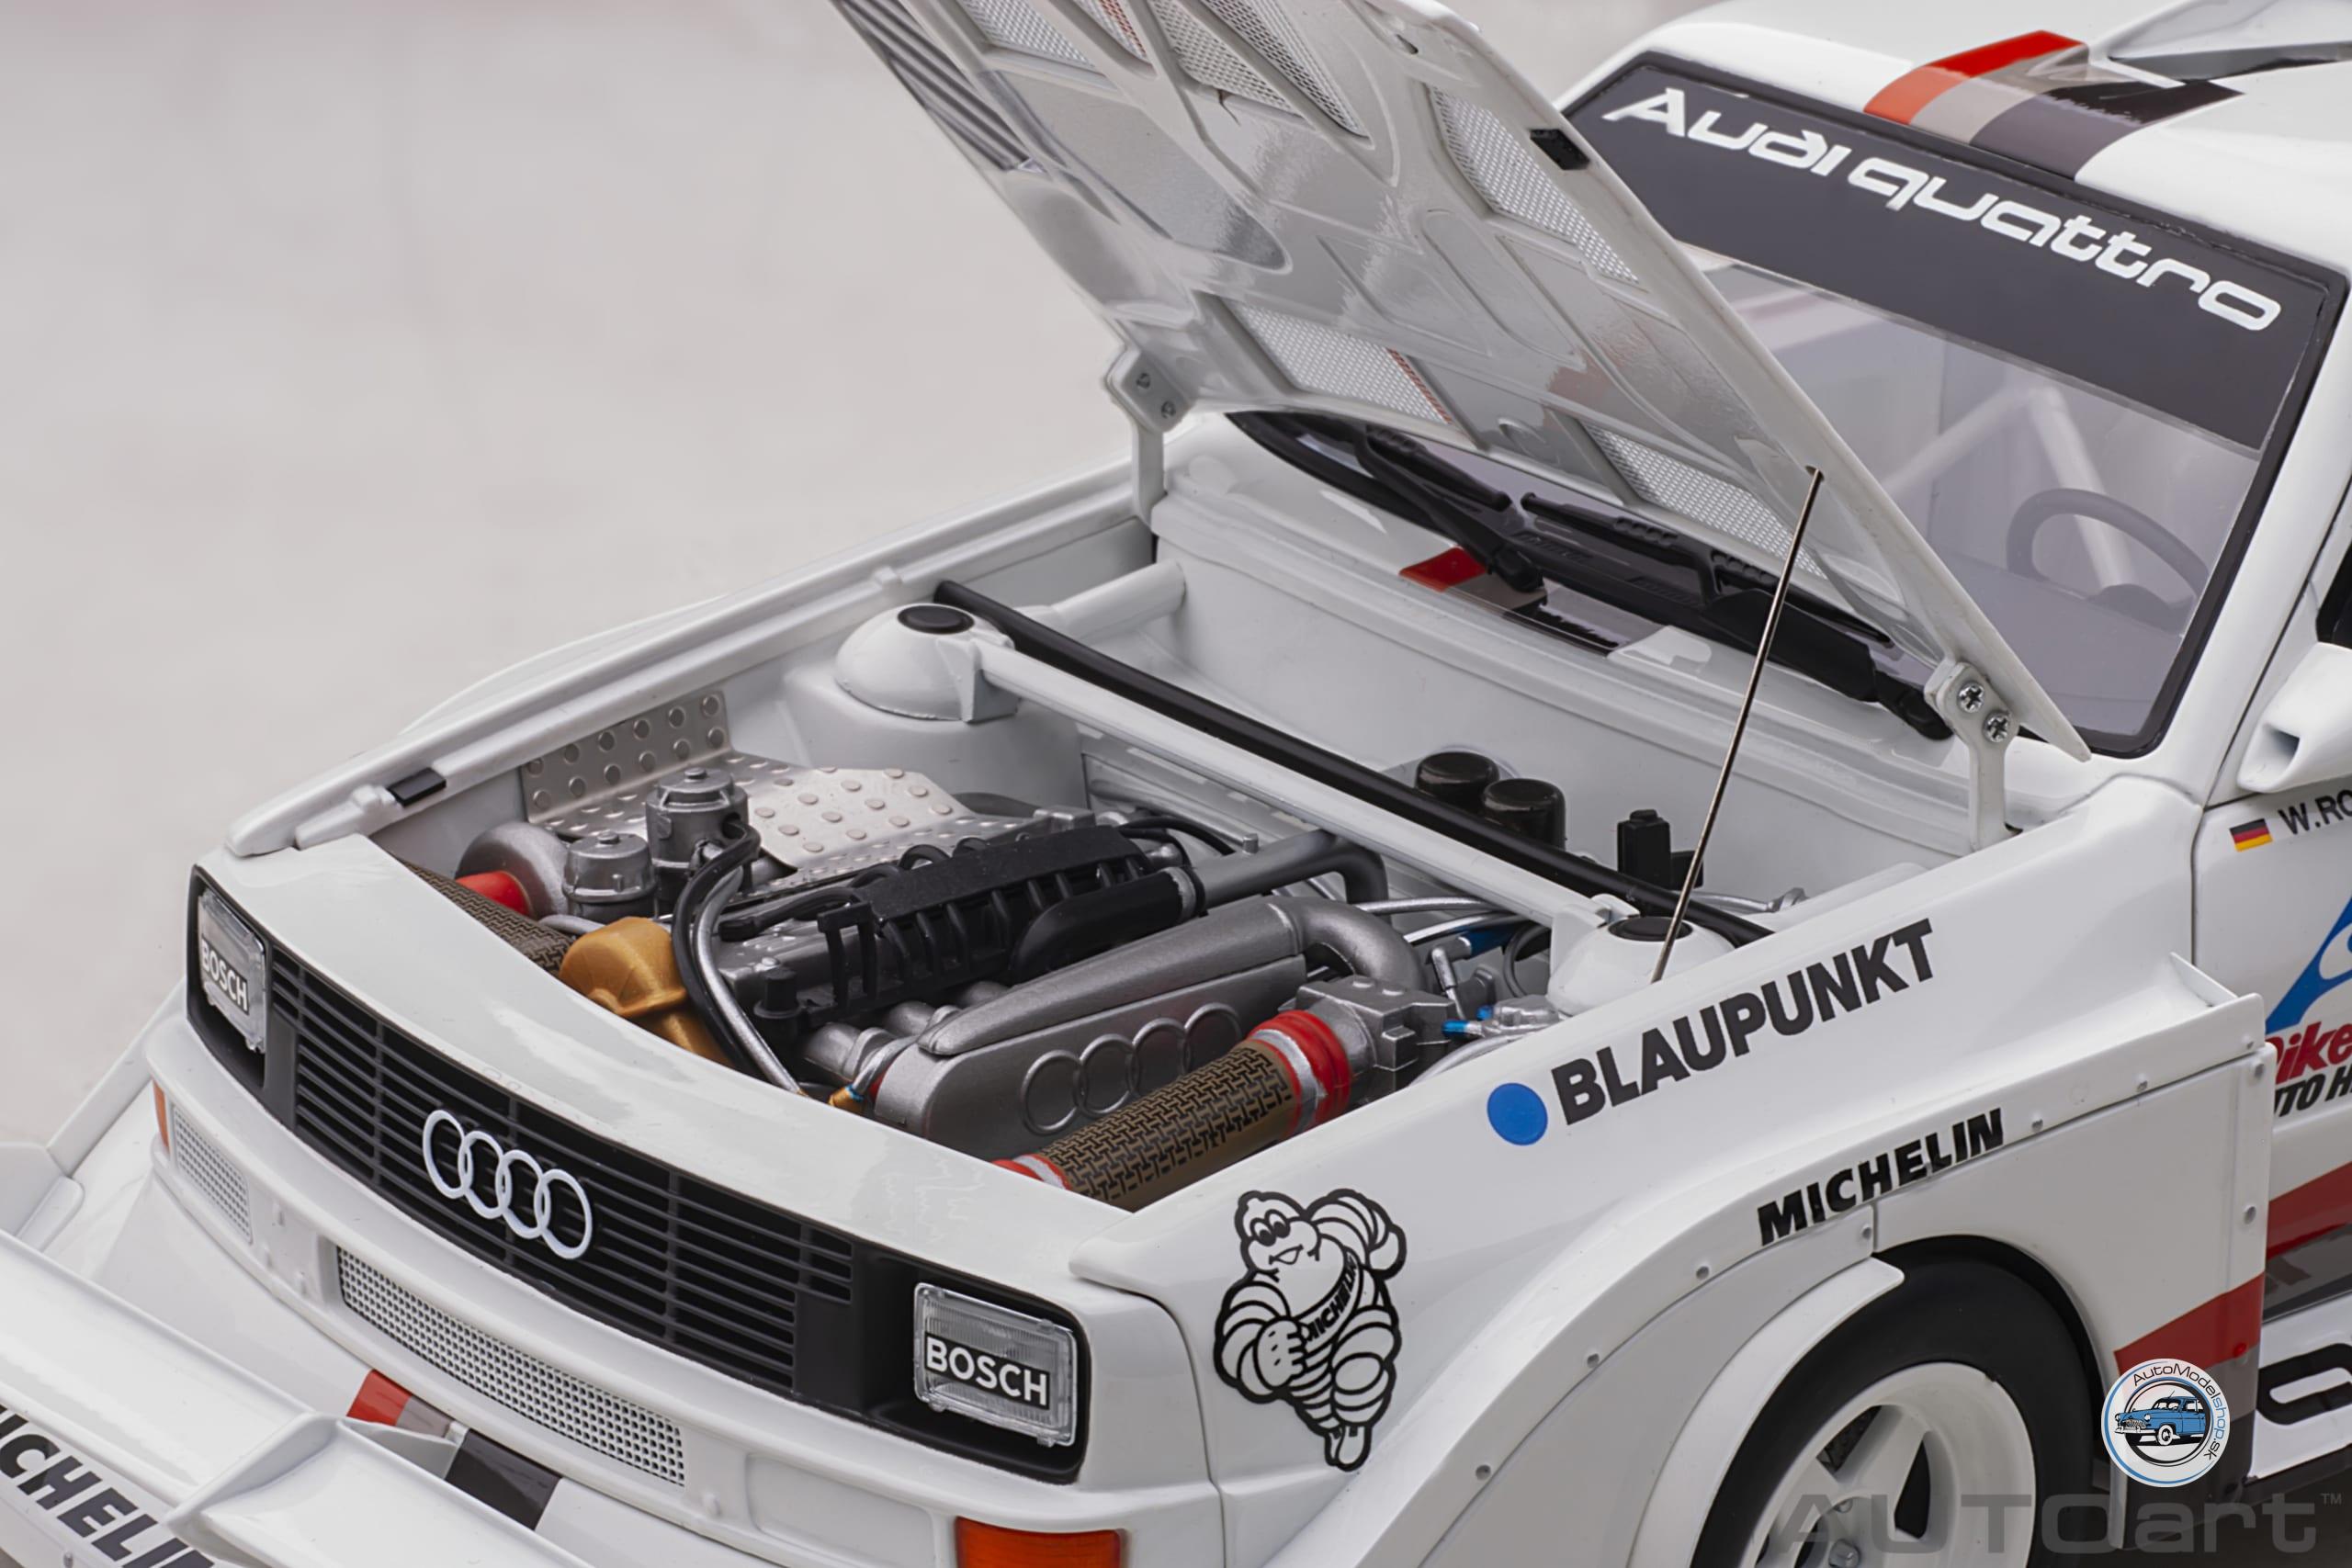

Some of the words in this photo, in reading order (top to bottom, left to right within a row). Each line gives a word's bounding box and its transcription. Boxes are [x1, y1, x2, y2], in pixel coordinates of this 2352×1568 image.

[1602, 87, 1851, 176] Audi
[1847, 156, 2282, 332] quattro
[201, 938, 248, 1011] BOSCH
[1552, 918, 1934, 1125] BLAUPUNKT
[2274, 1074, 2325, 1118] TO
[1757, 1107, 2005, 1247] MICHELIN
[926, 1337, 1047, 1405] BOSCH
[0, 1403, 215, 1568] CHELI
